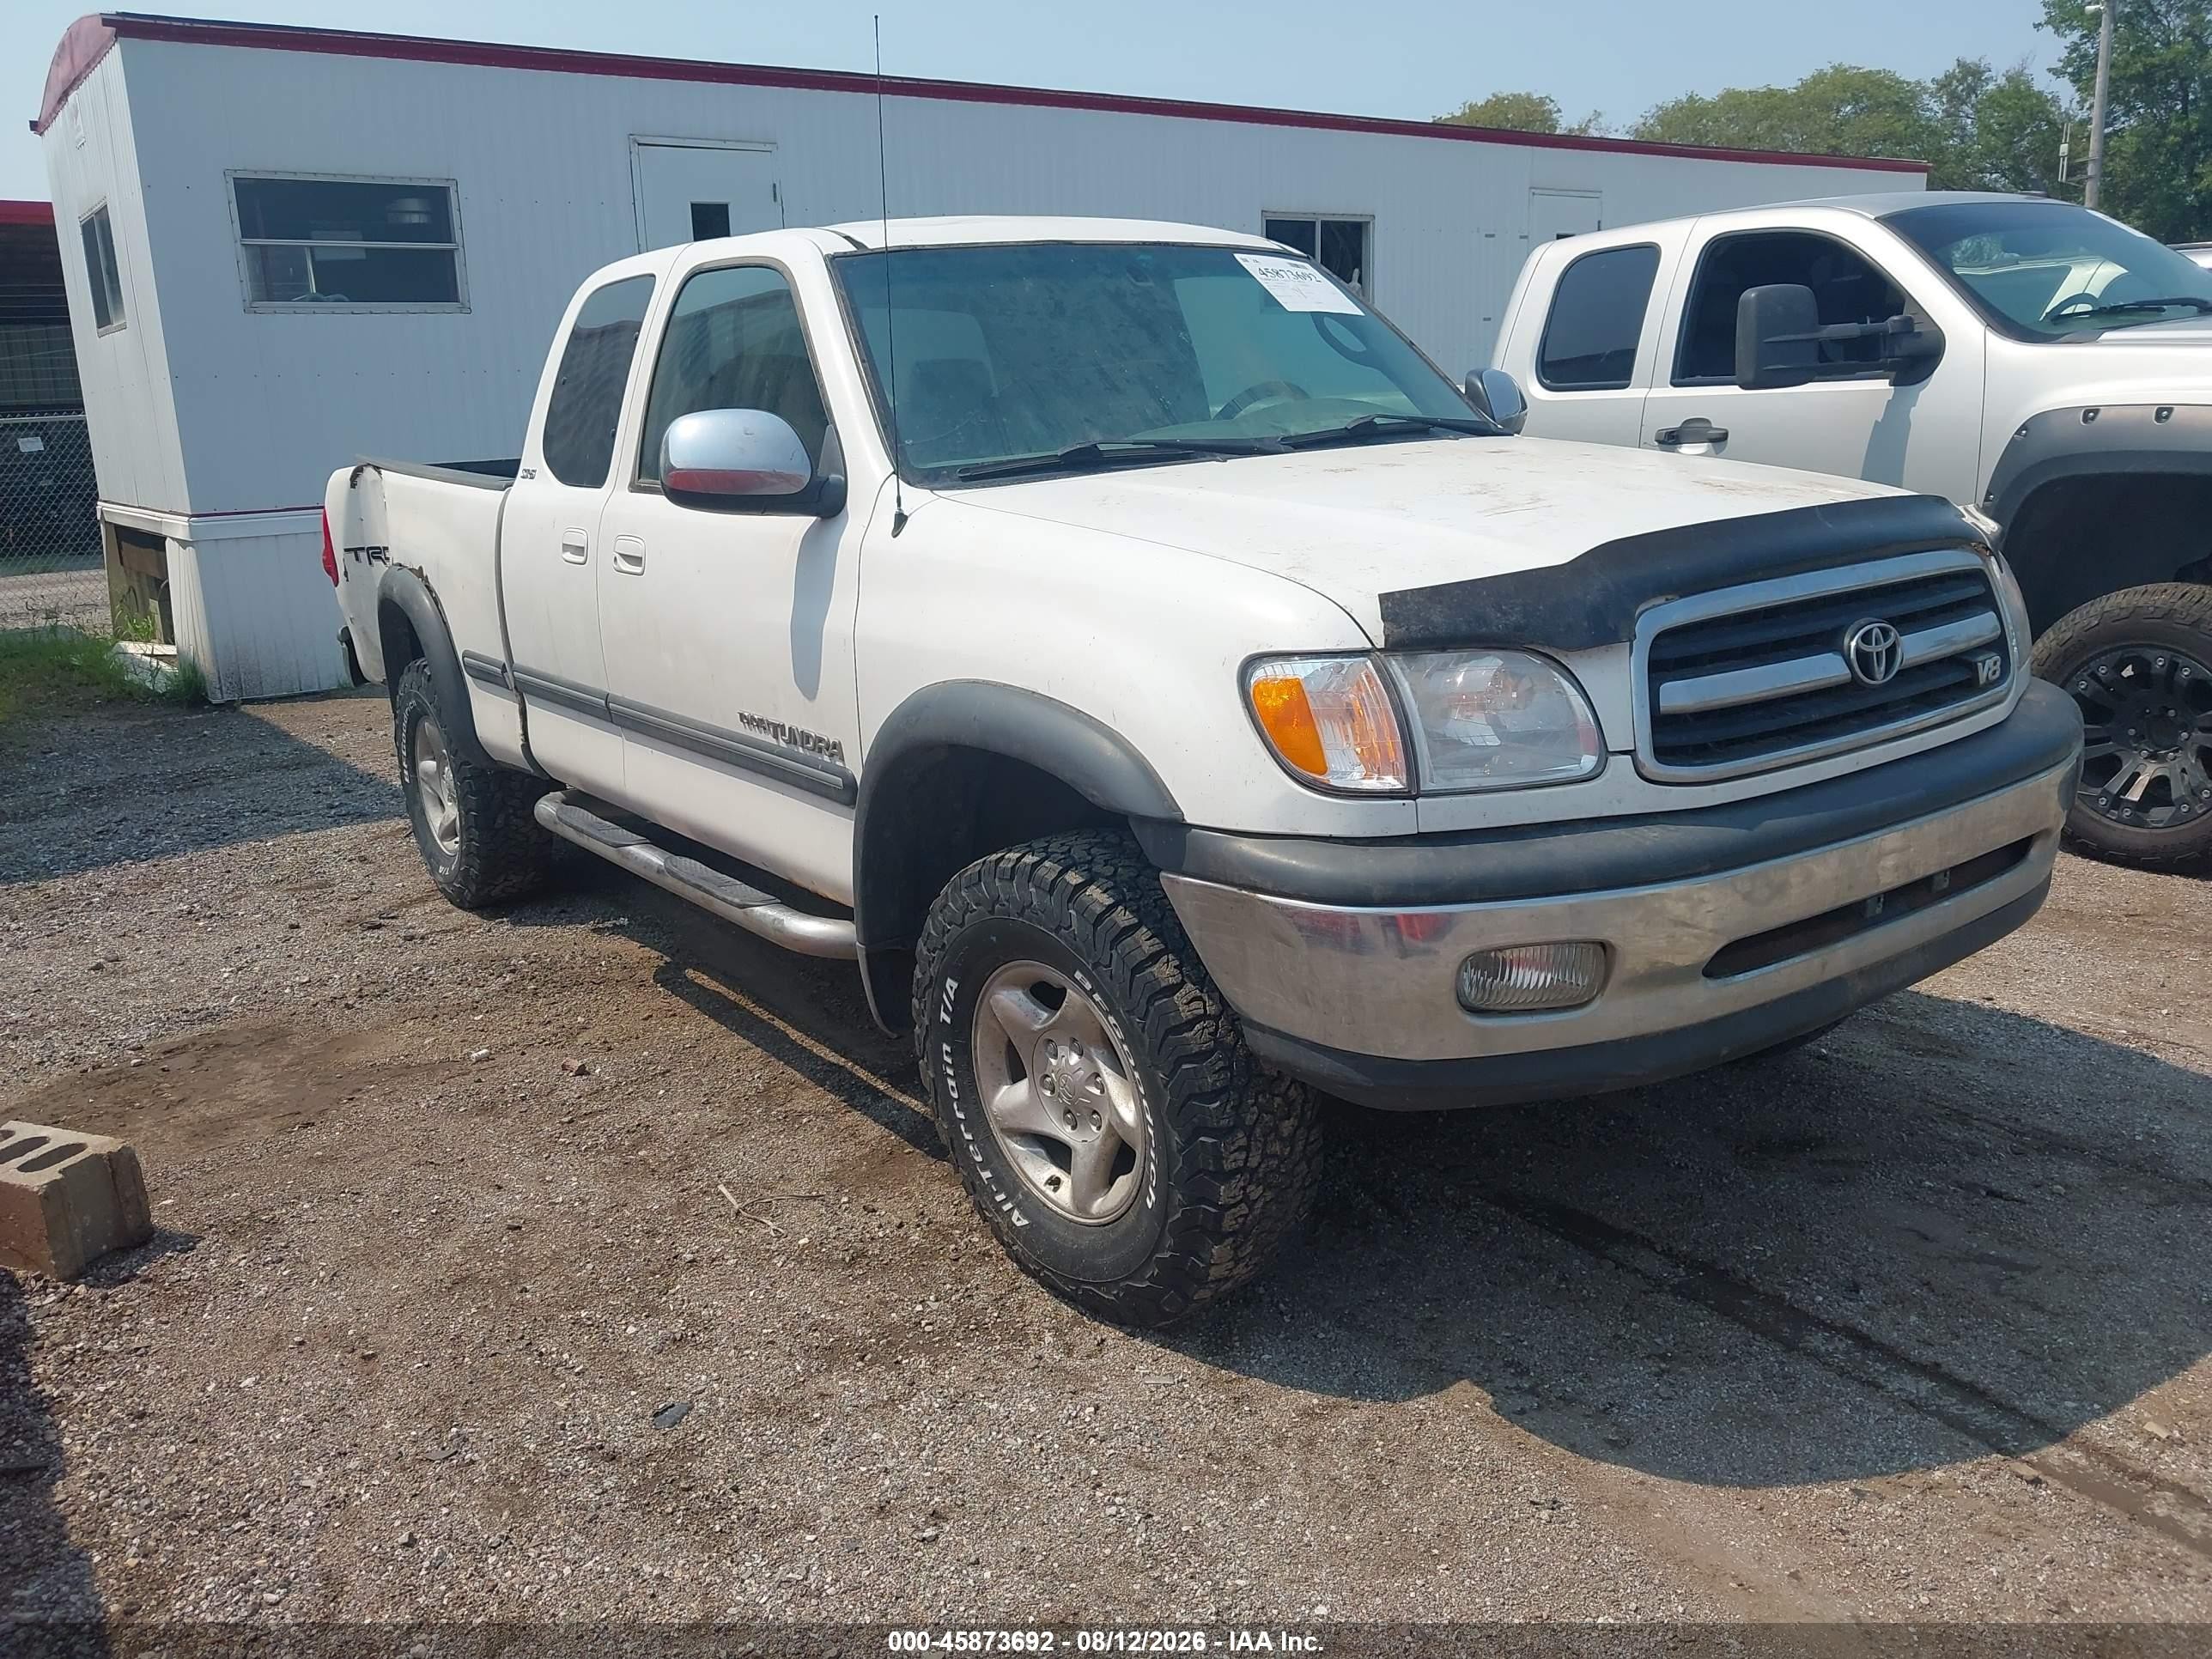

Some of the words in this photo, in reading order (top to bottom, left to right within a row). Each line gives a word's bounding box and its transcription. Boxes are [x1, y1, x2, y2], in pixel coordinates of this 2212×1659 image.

[1977, 655, 2001, 685] V8
[767, 719, 846, 766] TUNDRA
[939, 976, 959, 1025] T/A
